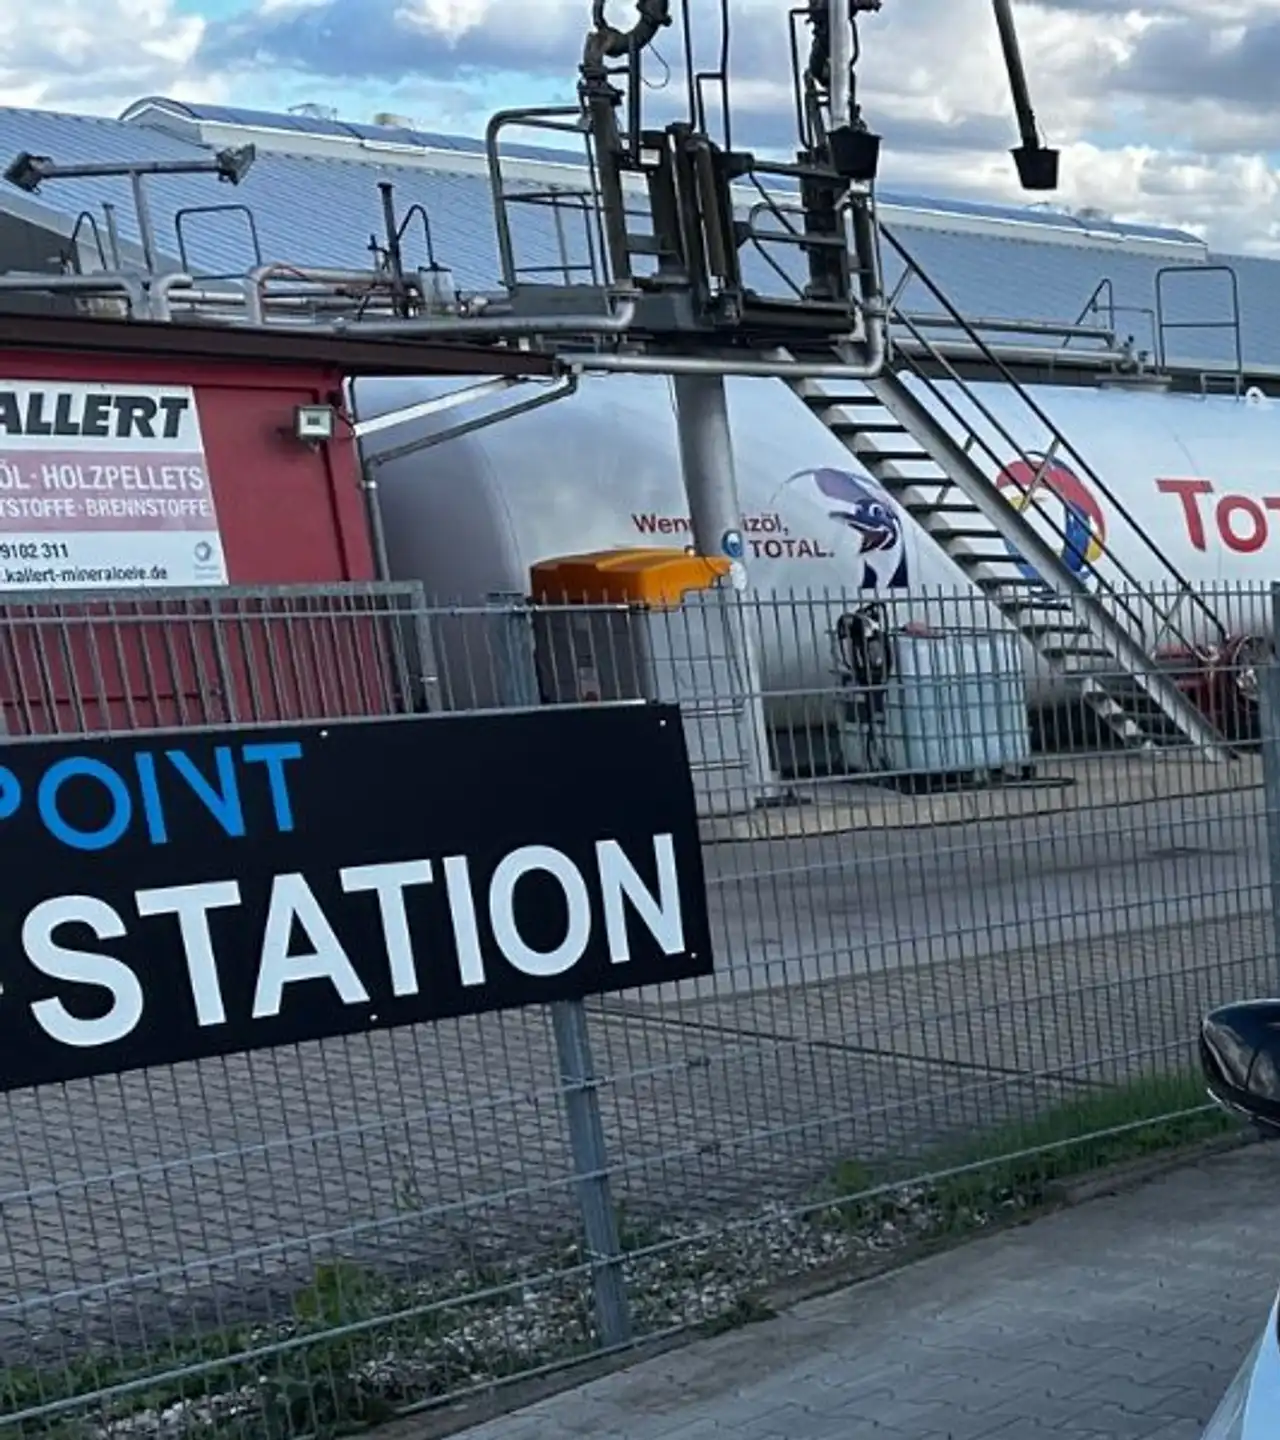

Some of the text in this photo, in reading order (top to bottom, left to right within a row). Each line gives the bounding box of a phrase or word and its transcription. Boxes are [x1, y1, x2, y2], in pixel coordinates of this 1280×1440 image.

[41, 464, 204, 490] HOLZPELLETS
[85, 498, 211, 517] BRENNSTOFFE
[741, 513, 788, 536] izöl,
[0, 832, 686, 1047] STATION
